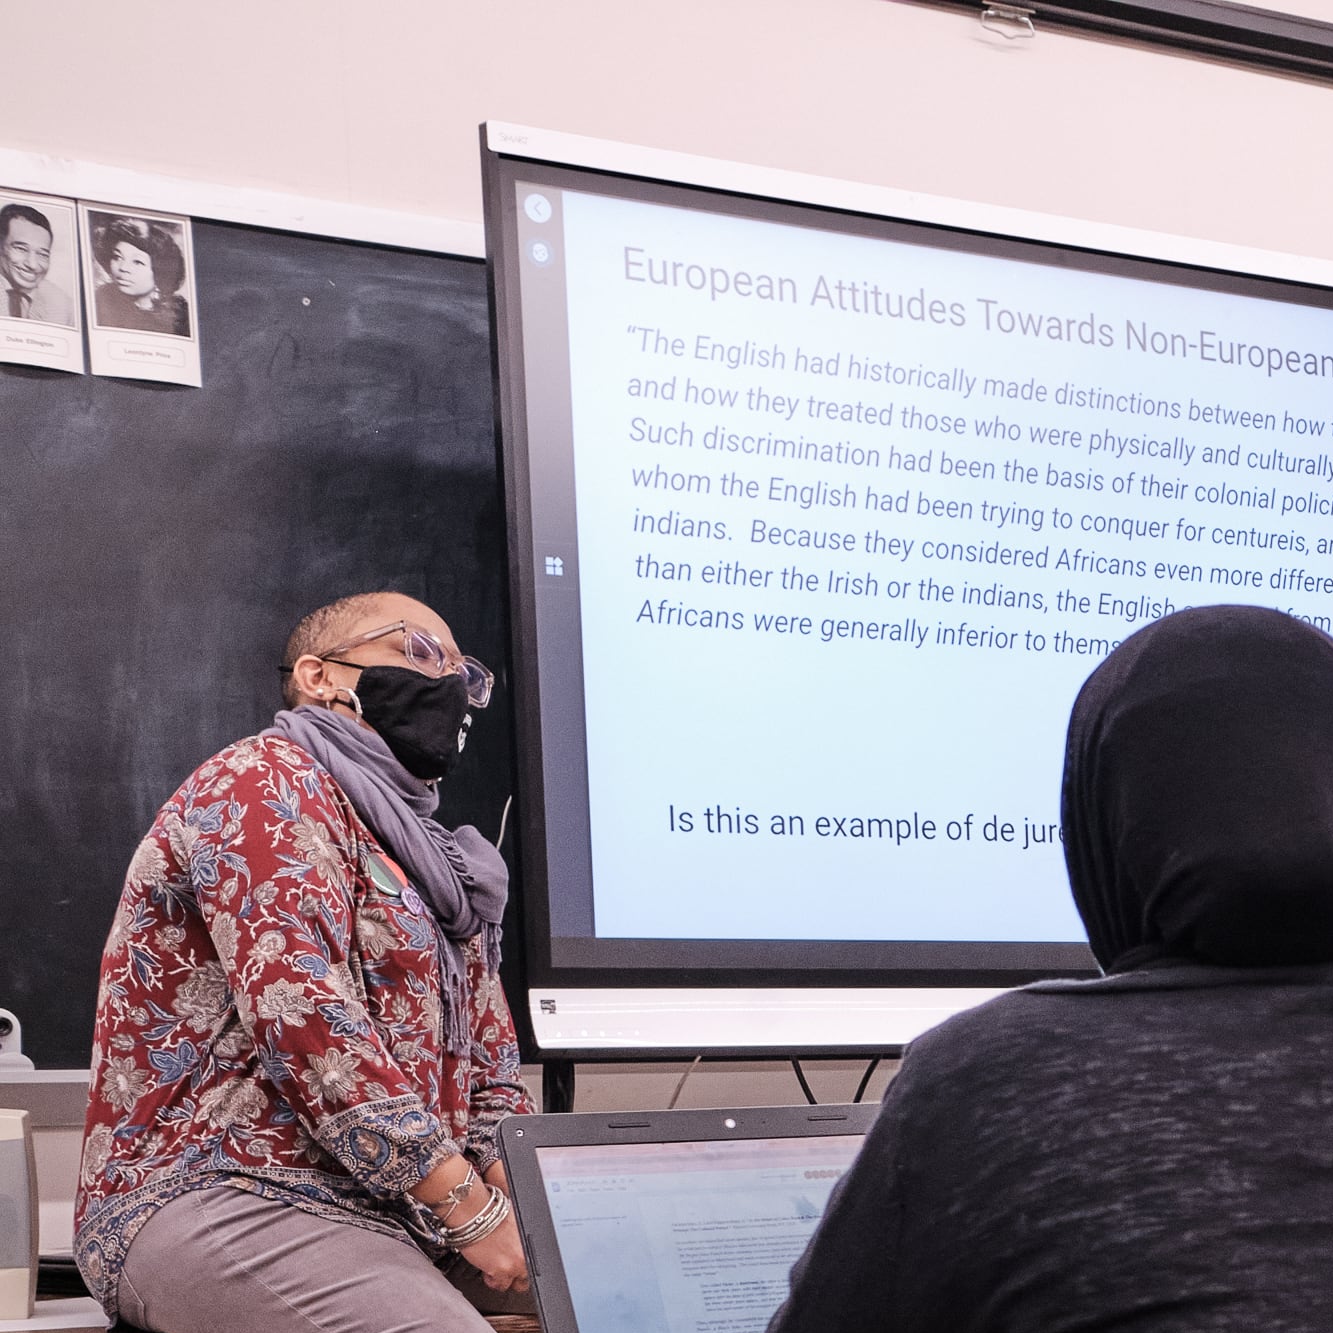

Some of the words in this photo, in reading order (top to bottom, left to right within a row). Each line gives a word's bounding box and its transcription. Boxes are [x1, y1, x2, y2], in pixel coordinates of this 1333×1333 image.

[624, 246, 797, 303] European
[810, 275, 966, 327] Attitudes
[977, 298, 1114, 347] Towards
[694, 335, 785, 369] English
[795, 347, 840, 376] had
[848, 354, 977, 399] historically
[984, 378, 1047, 402] made
[1055, 383, 1181, 419] distinctions
[1189, 399, 1275, 430] between
[1283, 411, 1325, 436] how
[632, 464, 710, 493] whom
[720, 472, 759, 498] the
[769, 477, 856, 509] English
[865, 486, 909, 513] had
[917, 491, 972, 519] been
[981, 501, 1044, 531] trying
[1052, 508, 1072, 529] to
[1081, 515, 1169, 540] conquer
[1177, 518, 1205, 541] for
[1212, 528, 1309, 555] centureis,
[636, 600, 744, 630] Africans
[754, 614, 812, 635] were
[821, 618, 928, 648] generally
[937, 623, 1018, 648] inferior
[1025, 630, 1045, 651] to
[1053, 632, 1121, 658] thems
[670, 805, 693, 832] Is
[704, 805, 759, 834] this
[771, 815, 804, 835] an
[816, 812, 936, 846] example
[947, 814, 973, 840] of
[983, 815, 1014, 842] de
